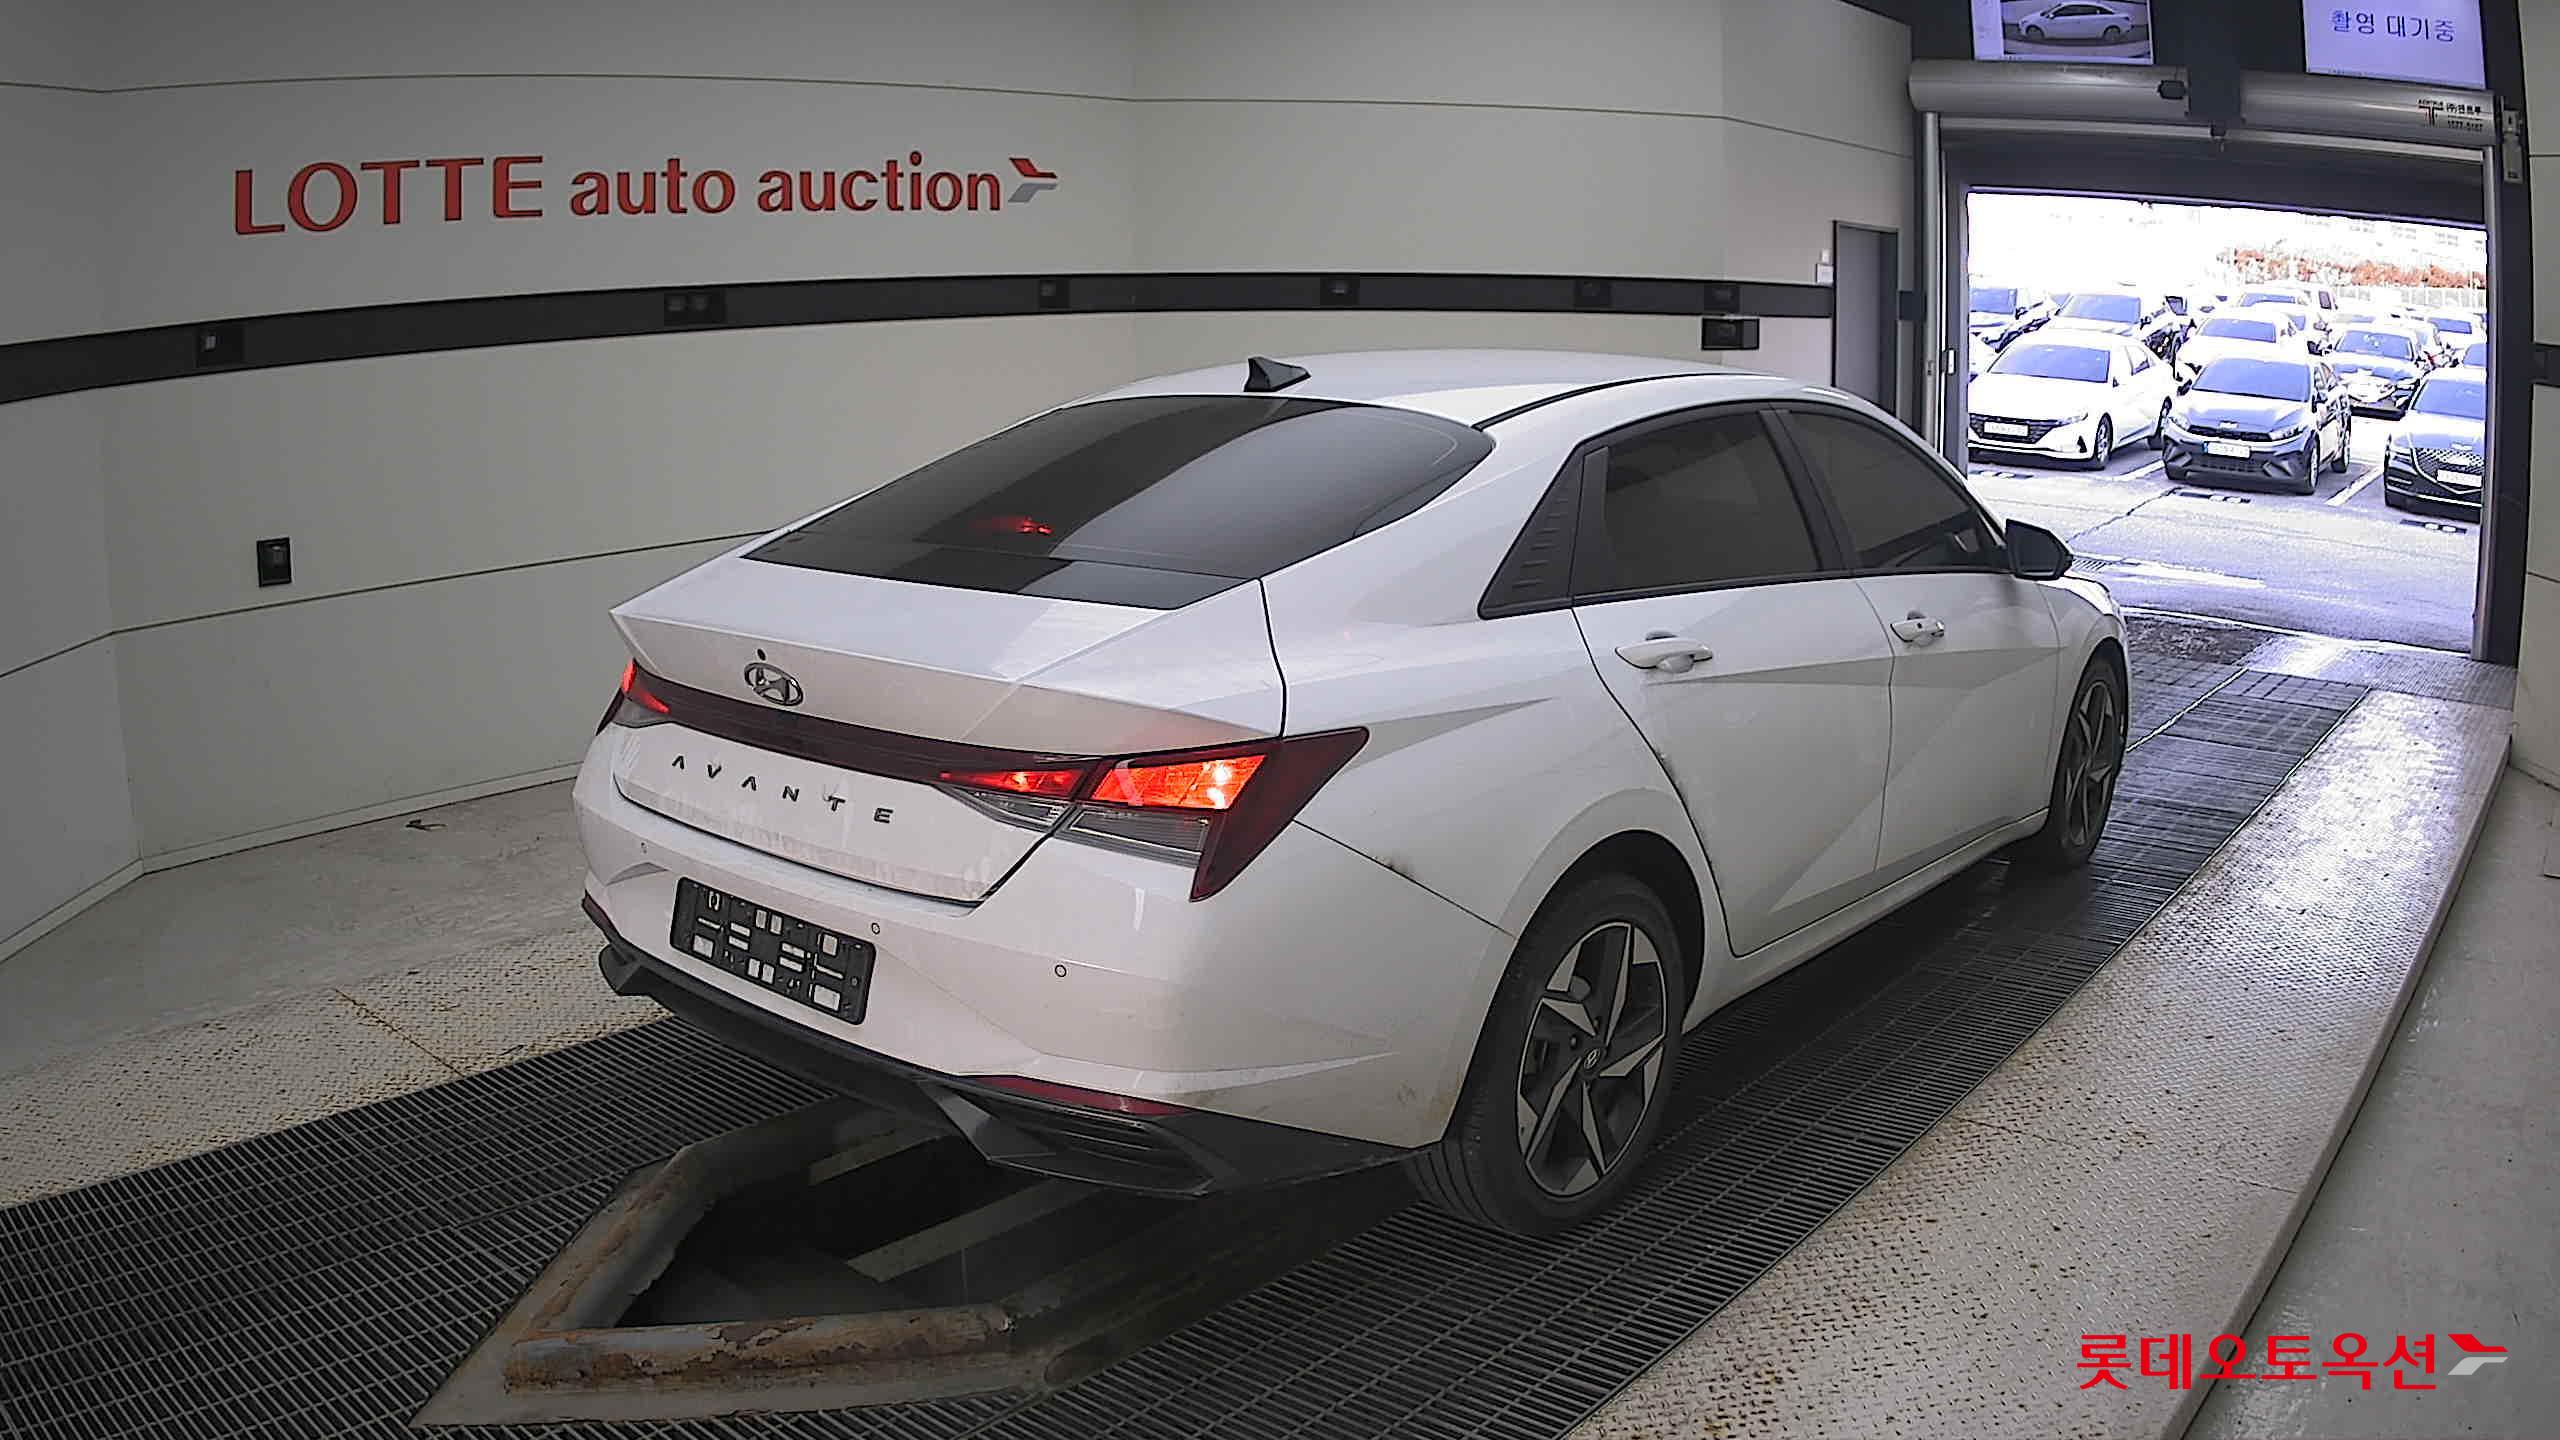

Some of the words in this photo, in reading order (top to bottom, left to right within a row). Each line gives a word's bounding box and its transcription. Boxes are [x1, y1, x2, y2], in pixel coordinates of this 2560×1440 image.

[2331, 10, 2375, 35] 촬영
[2386, 15, 2455, 42] 대기중
[234, 155, 543, 235] LOTTE
[569, 158, 736, 216] auto
[758, 150, 1001, 212] auction
[671, 755, 893, 824] AVANTE
